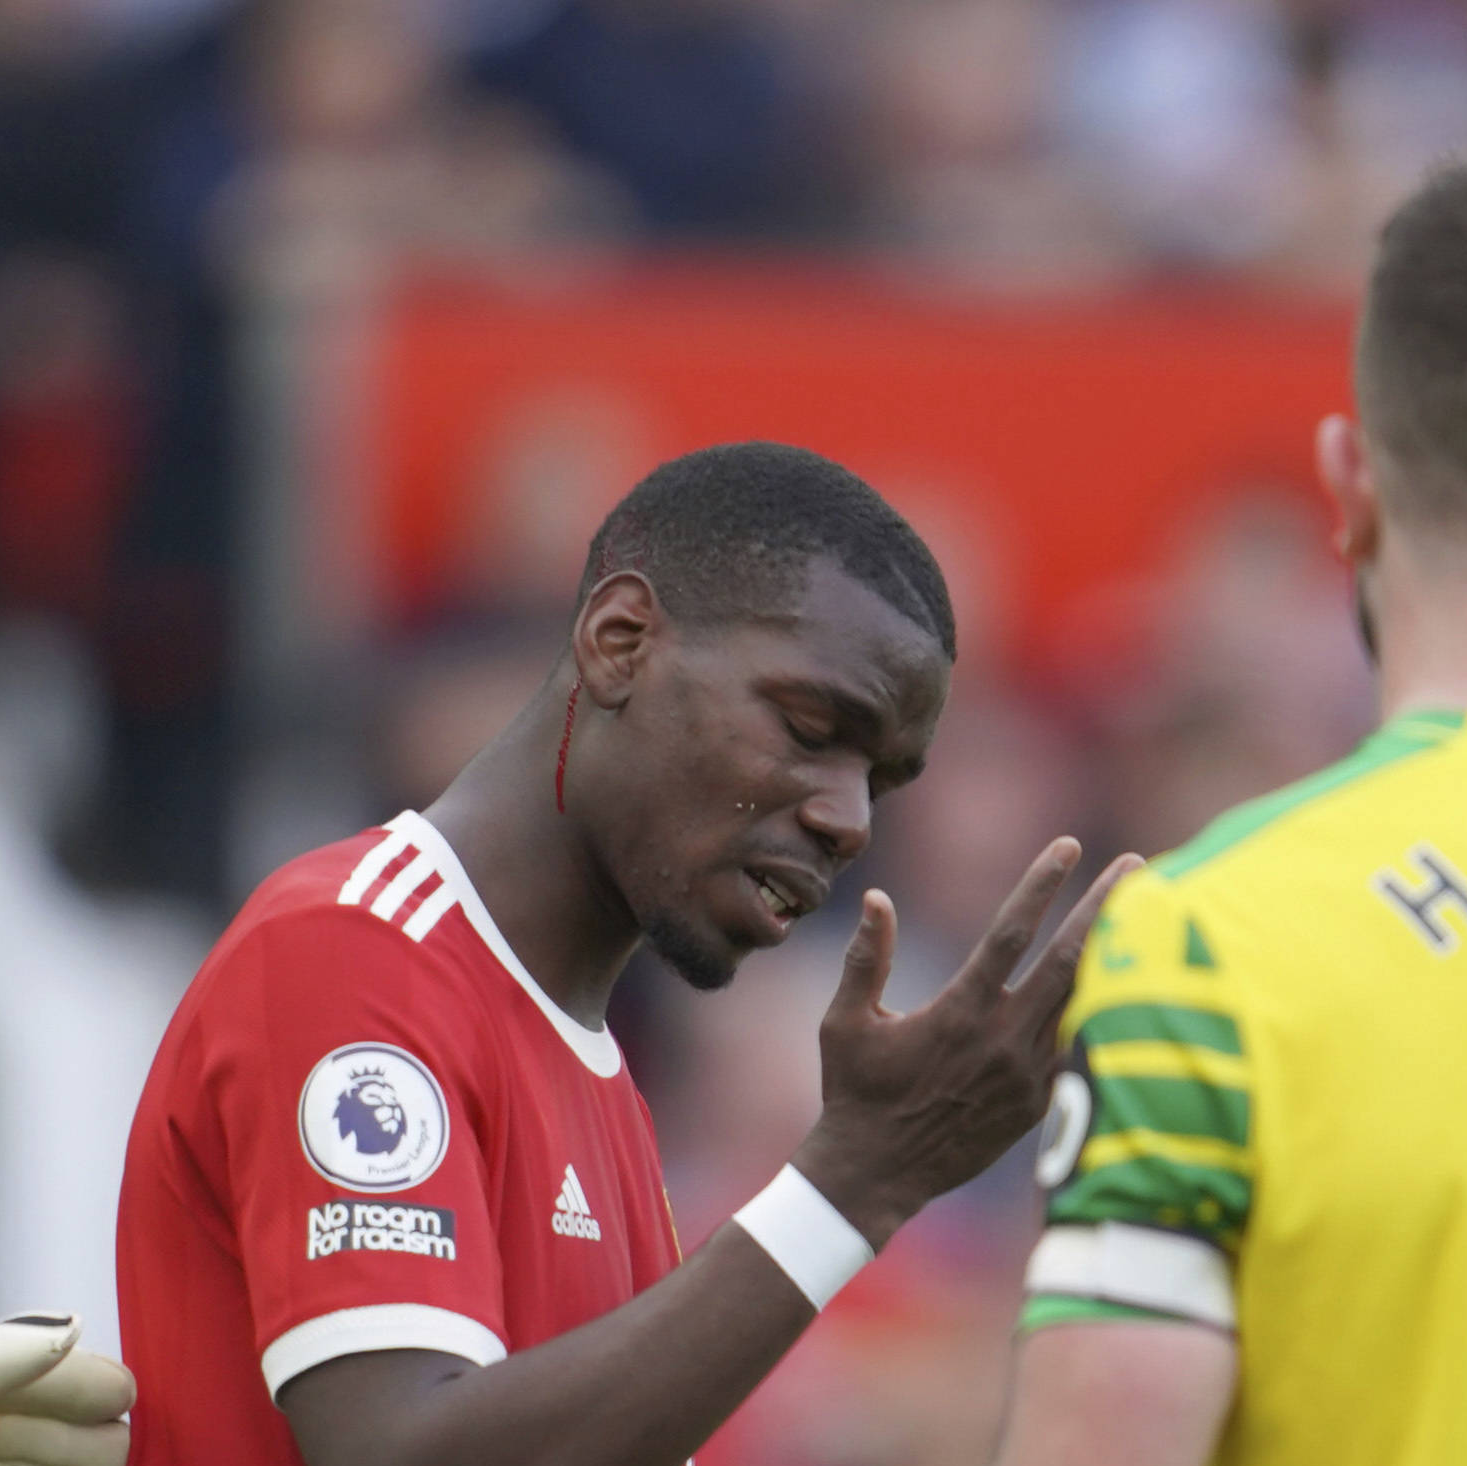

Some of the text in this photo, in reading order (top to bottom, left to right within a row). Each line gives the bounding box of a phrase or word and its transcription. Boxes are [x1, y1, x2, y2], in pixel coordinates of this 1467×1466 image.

[308, 1203, 441, 1235] No room
[552, 1209, 601, 1241] adidas
[307, 1227, 456, 1261] for racism
